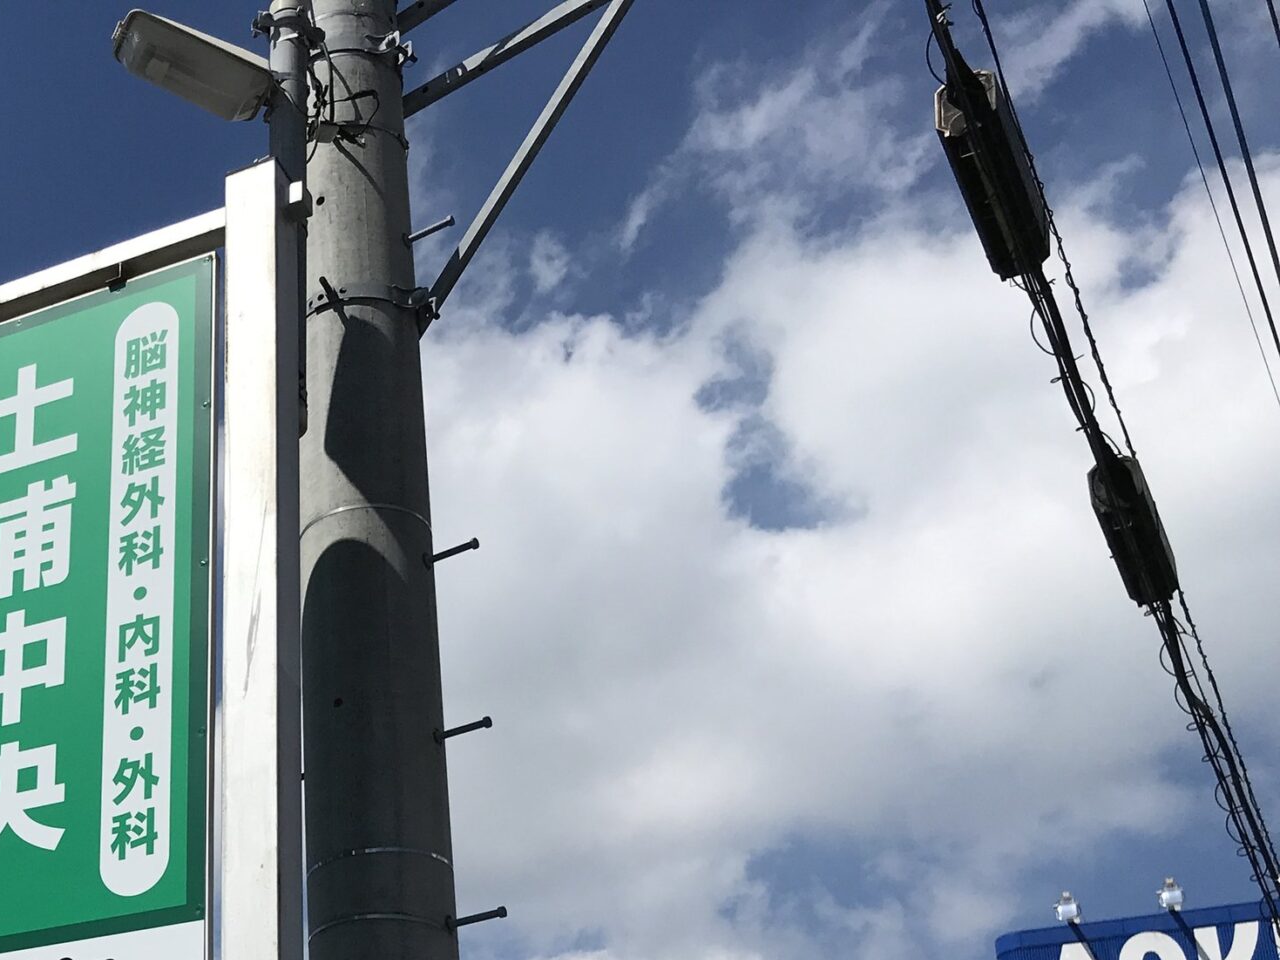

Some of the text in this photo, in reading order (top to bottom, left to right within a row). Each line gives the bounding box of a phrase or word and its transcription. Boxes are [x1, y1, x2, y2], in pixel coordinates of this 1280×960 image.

[110, 329, 168, 861] 脳神経外科・内科・外科
